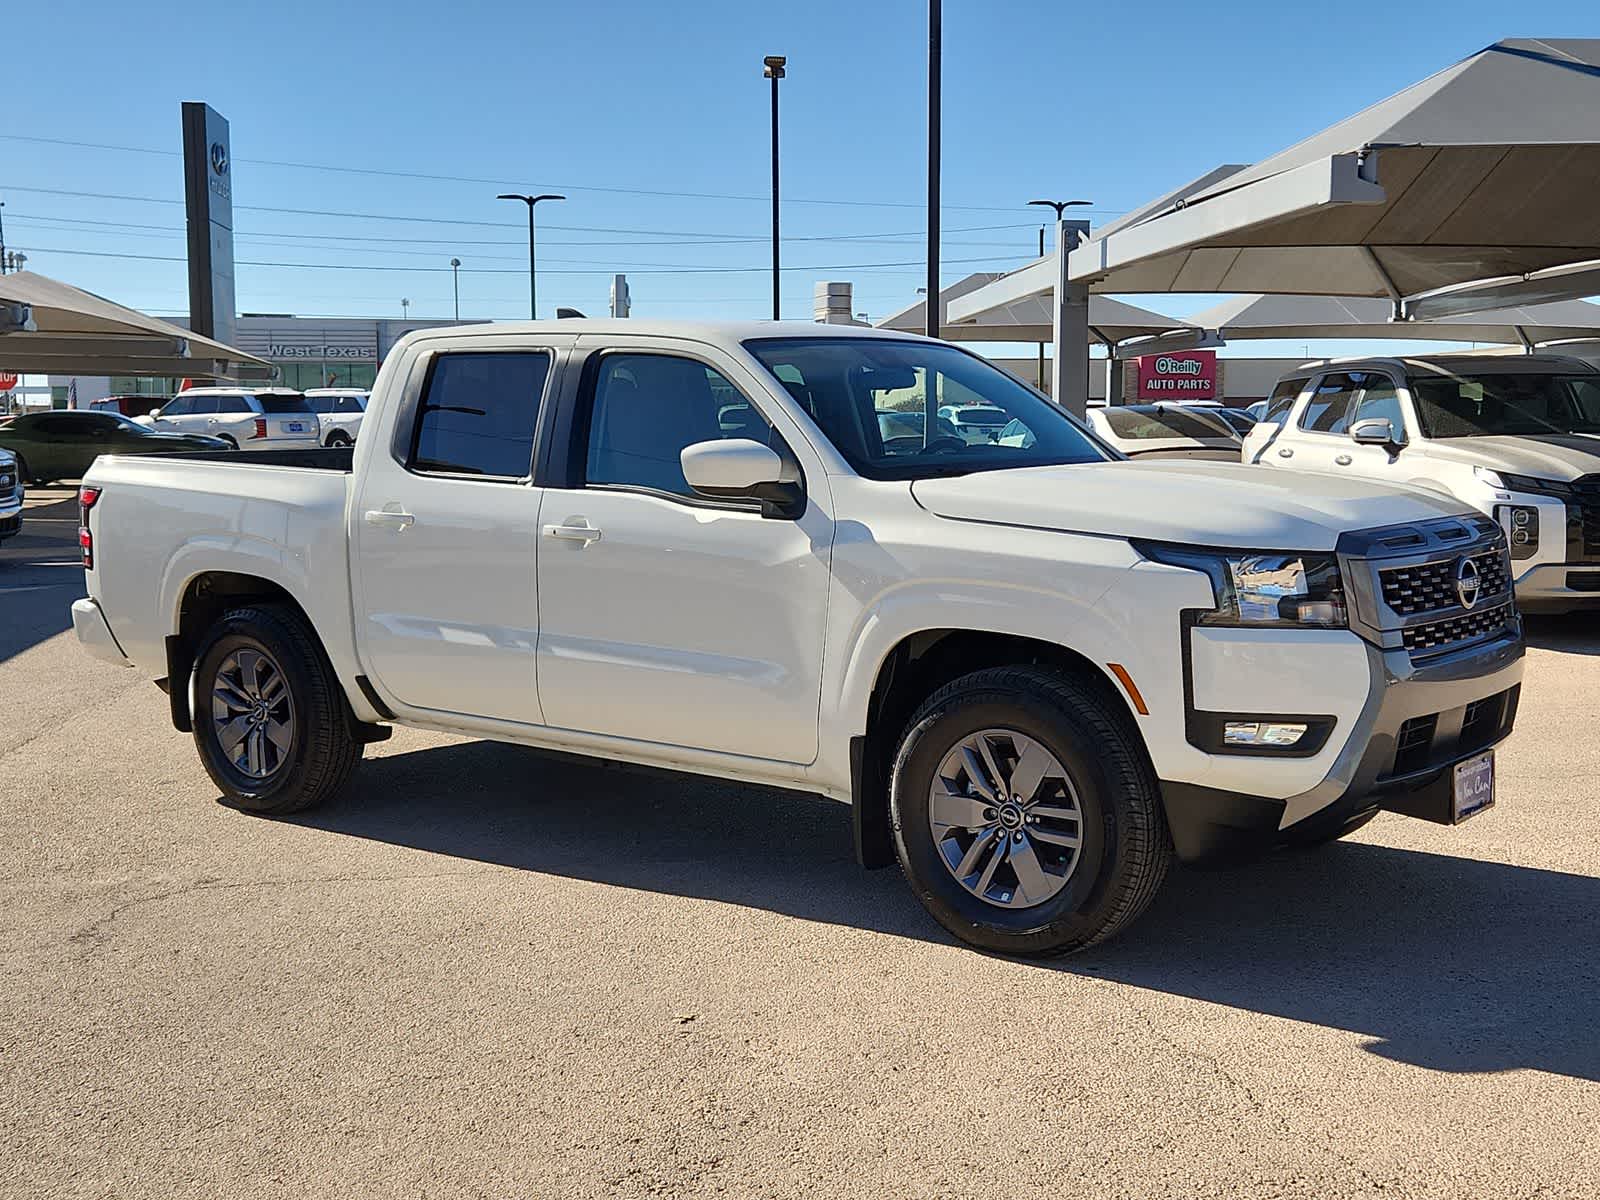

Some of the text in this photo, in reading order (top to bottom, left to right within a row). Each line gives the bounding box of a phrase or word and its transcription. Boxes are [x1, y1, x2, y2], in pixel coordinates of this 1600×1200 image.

[267, 344, 370, 358] West Texas
[1156, 357, 1202, 375] O'Reilly
[0, 372, 17, 383] TOP
[1147, 379, 1211, 390] AUTO PARTS
